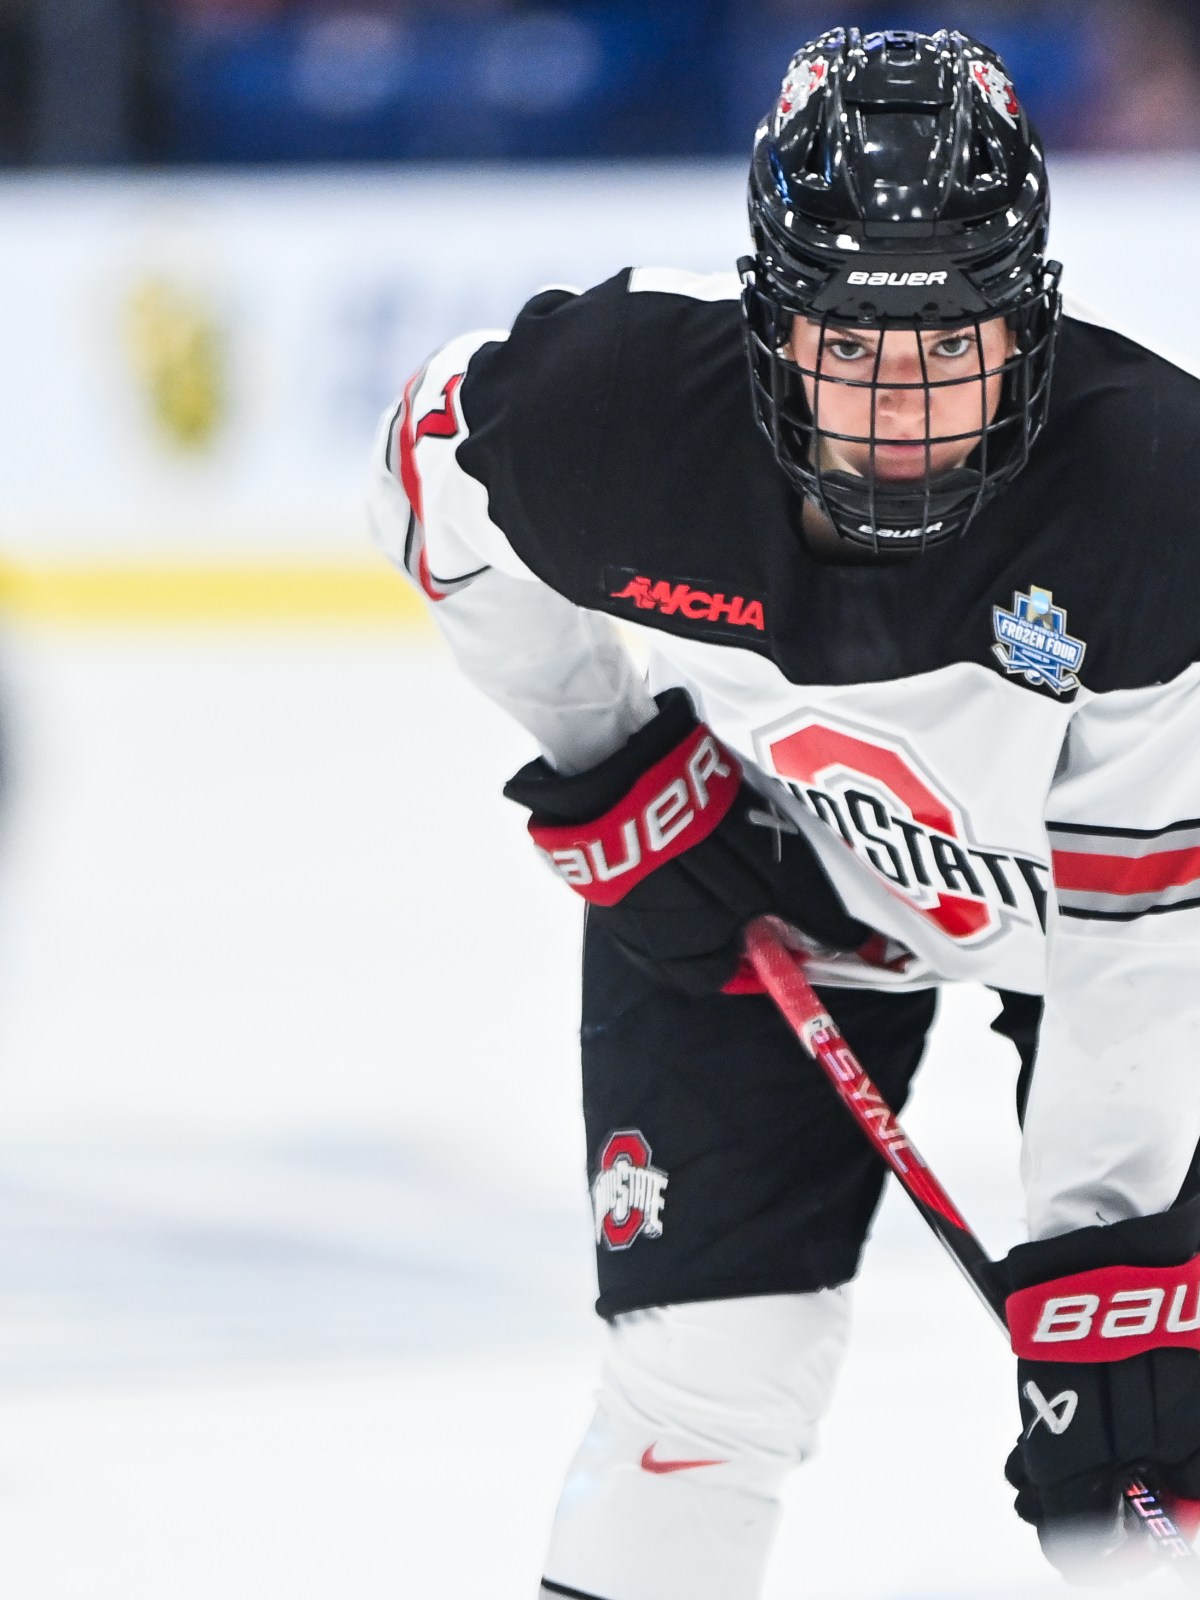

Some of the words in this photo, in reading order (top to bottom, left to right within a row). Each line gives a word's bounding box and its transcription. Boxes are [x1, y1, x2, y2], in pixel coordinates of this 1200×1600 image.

[1001, 618, 1046, 650] FROZEN
[1045, 637, 1078, 663] FOUR
[550, 735, 731, 886] AUER
[825, 1046, 928, 1173] SYNC
[1126, 1480, 1192, 1558] AUER
